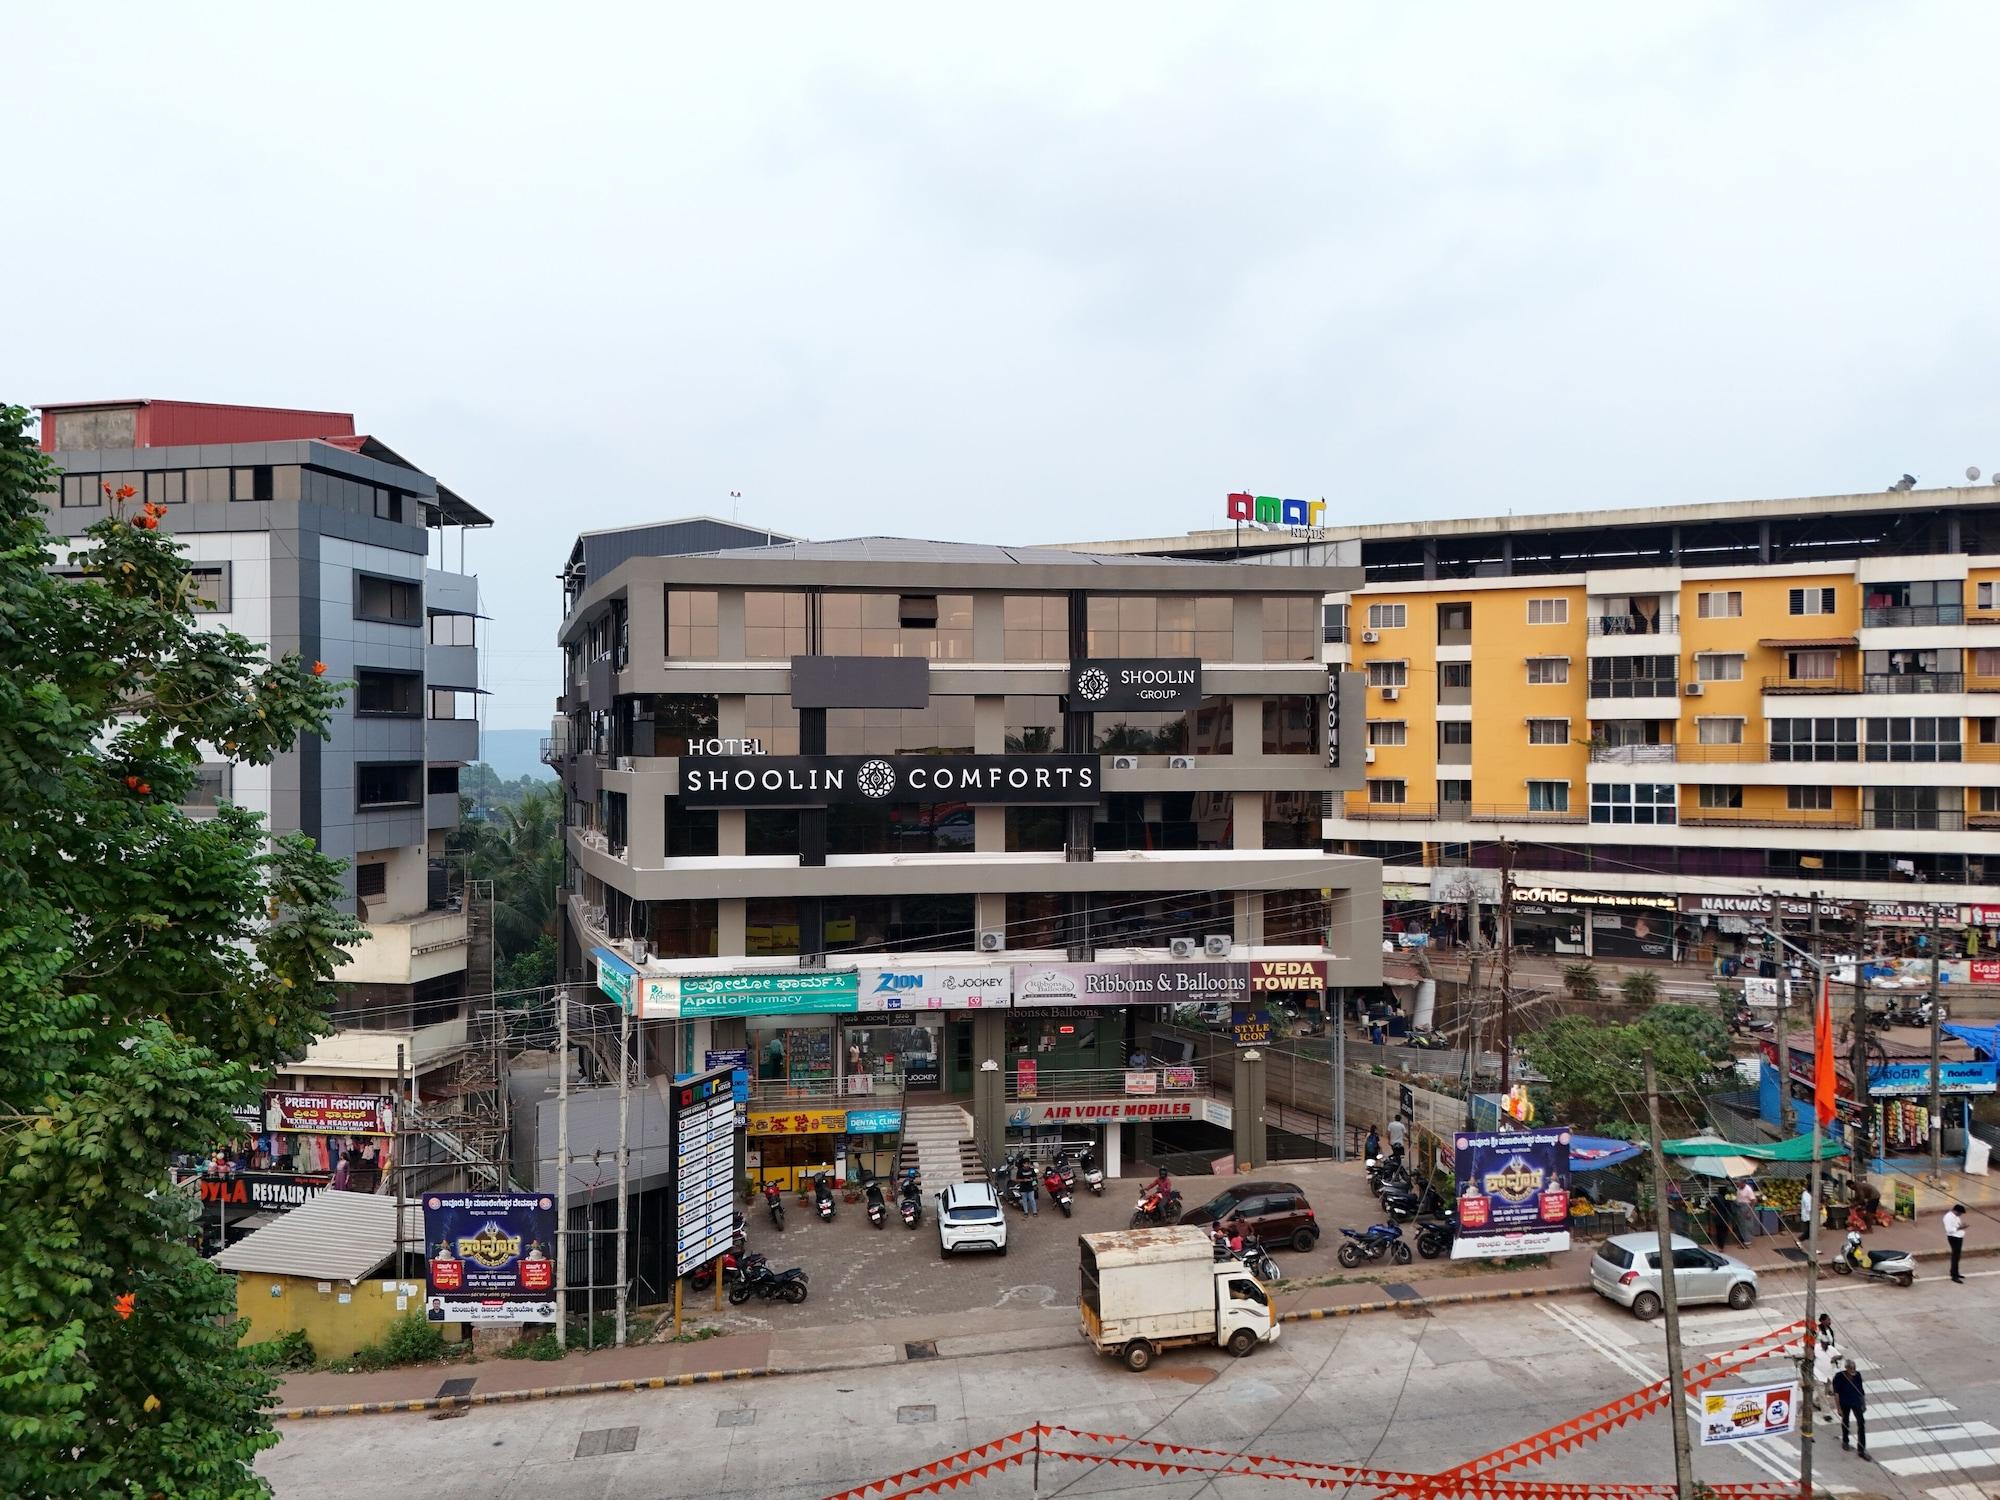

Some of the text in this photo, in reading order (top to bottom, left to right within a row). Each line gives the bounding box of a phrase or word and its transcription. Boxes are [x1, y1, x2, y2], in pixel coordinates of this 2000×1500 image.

[1120, 670, 1195, 684] SHOOLIN
[1139, 689, 1177, 700] GROUP
[1327, 675, 1338, 763] ROOMS
[687, 738, 767, 756] HOTEL
[687, 767, 1093, 792] SHOOLIN COMFORTS
[1701, 897, 1771, 912] NAKWA'S
[1261, 962, 1315, 976] VEDA
[872, 973, 923, 994] ZION
[957, 978, 1003, 988] JOCKEY
[1085, 973, 1246, 993] Ribbons & Balloons
[1252, 977, 1323, 990] TOWER
[1234, 1023, 1270, 1034] STYLE
[1239, 1032, 1266, 1041] ICON
[907, 1073, 938, 1081] JOCKEY
[284, 1097, 375, 1111] PREETHI FASHION
[1044, 1107, 1073, 1118] AIR
[1073, 1105, 1120, 1118] VOICE
[1124, 1103, 1191, 1116] MOBILES
[285, 1117, 318, 1126] TEXTILES
[327, 1119, 374, 1128] READYMADE
[850, 1119, 877, 1127] DENTAL
[879, 1117, 901, 1126] CLINIC
[252, 1183, 324, 1204] RESTAURAN
